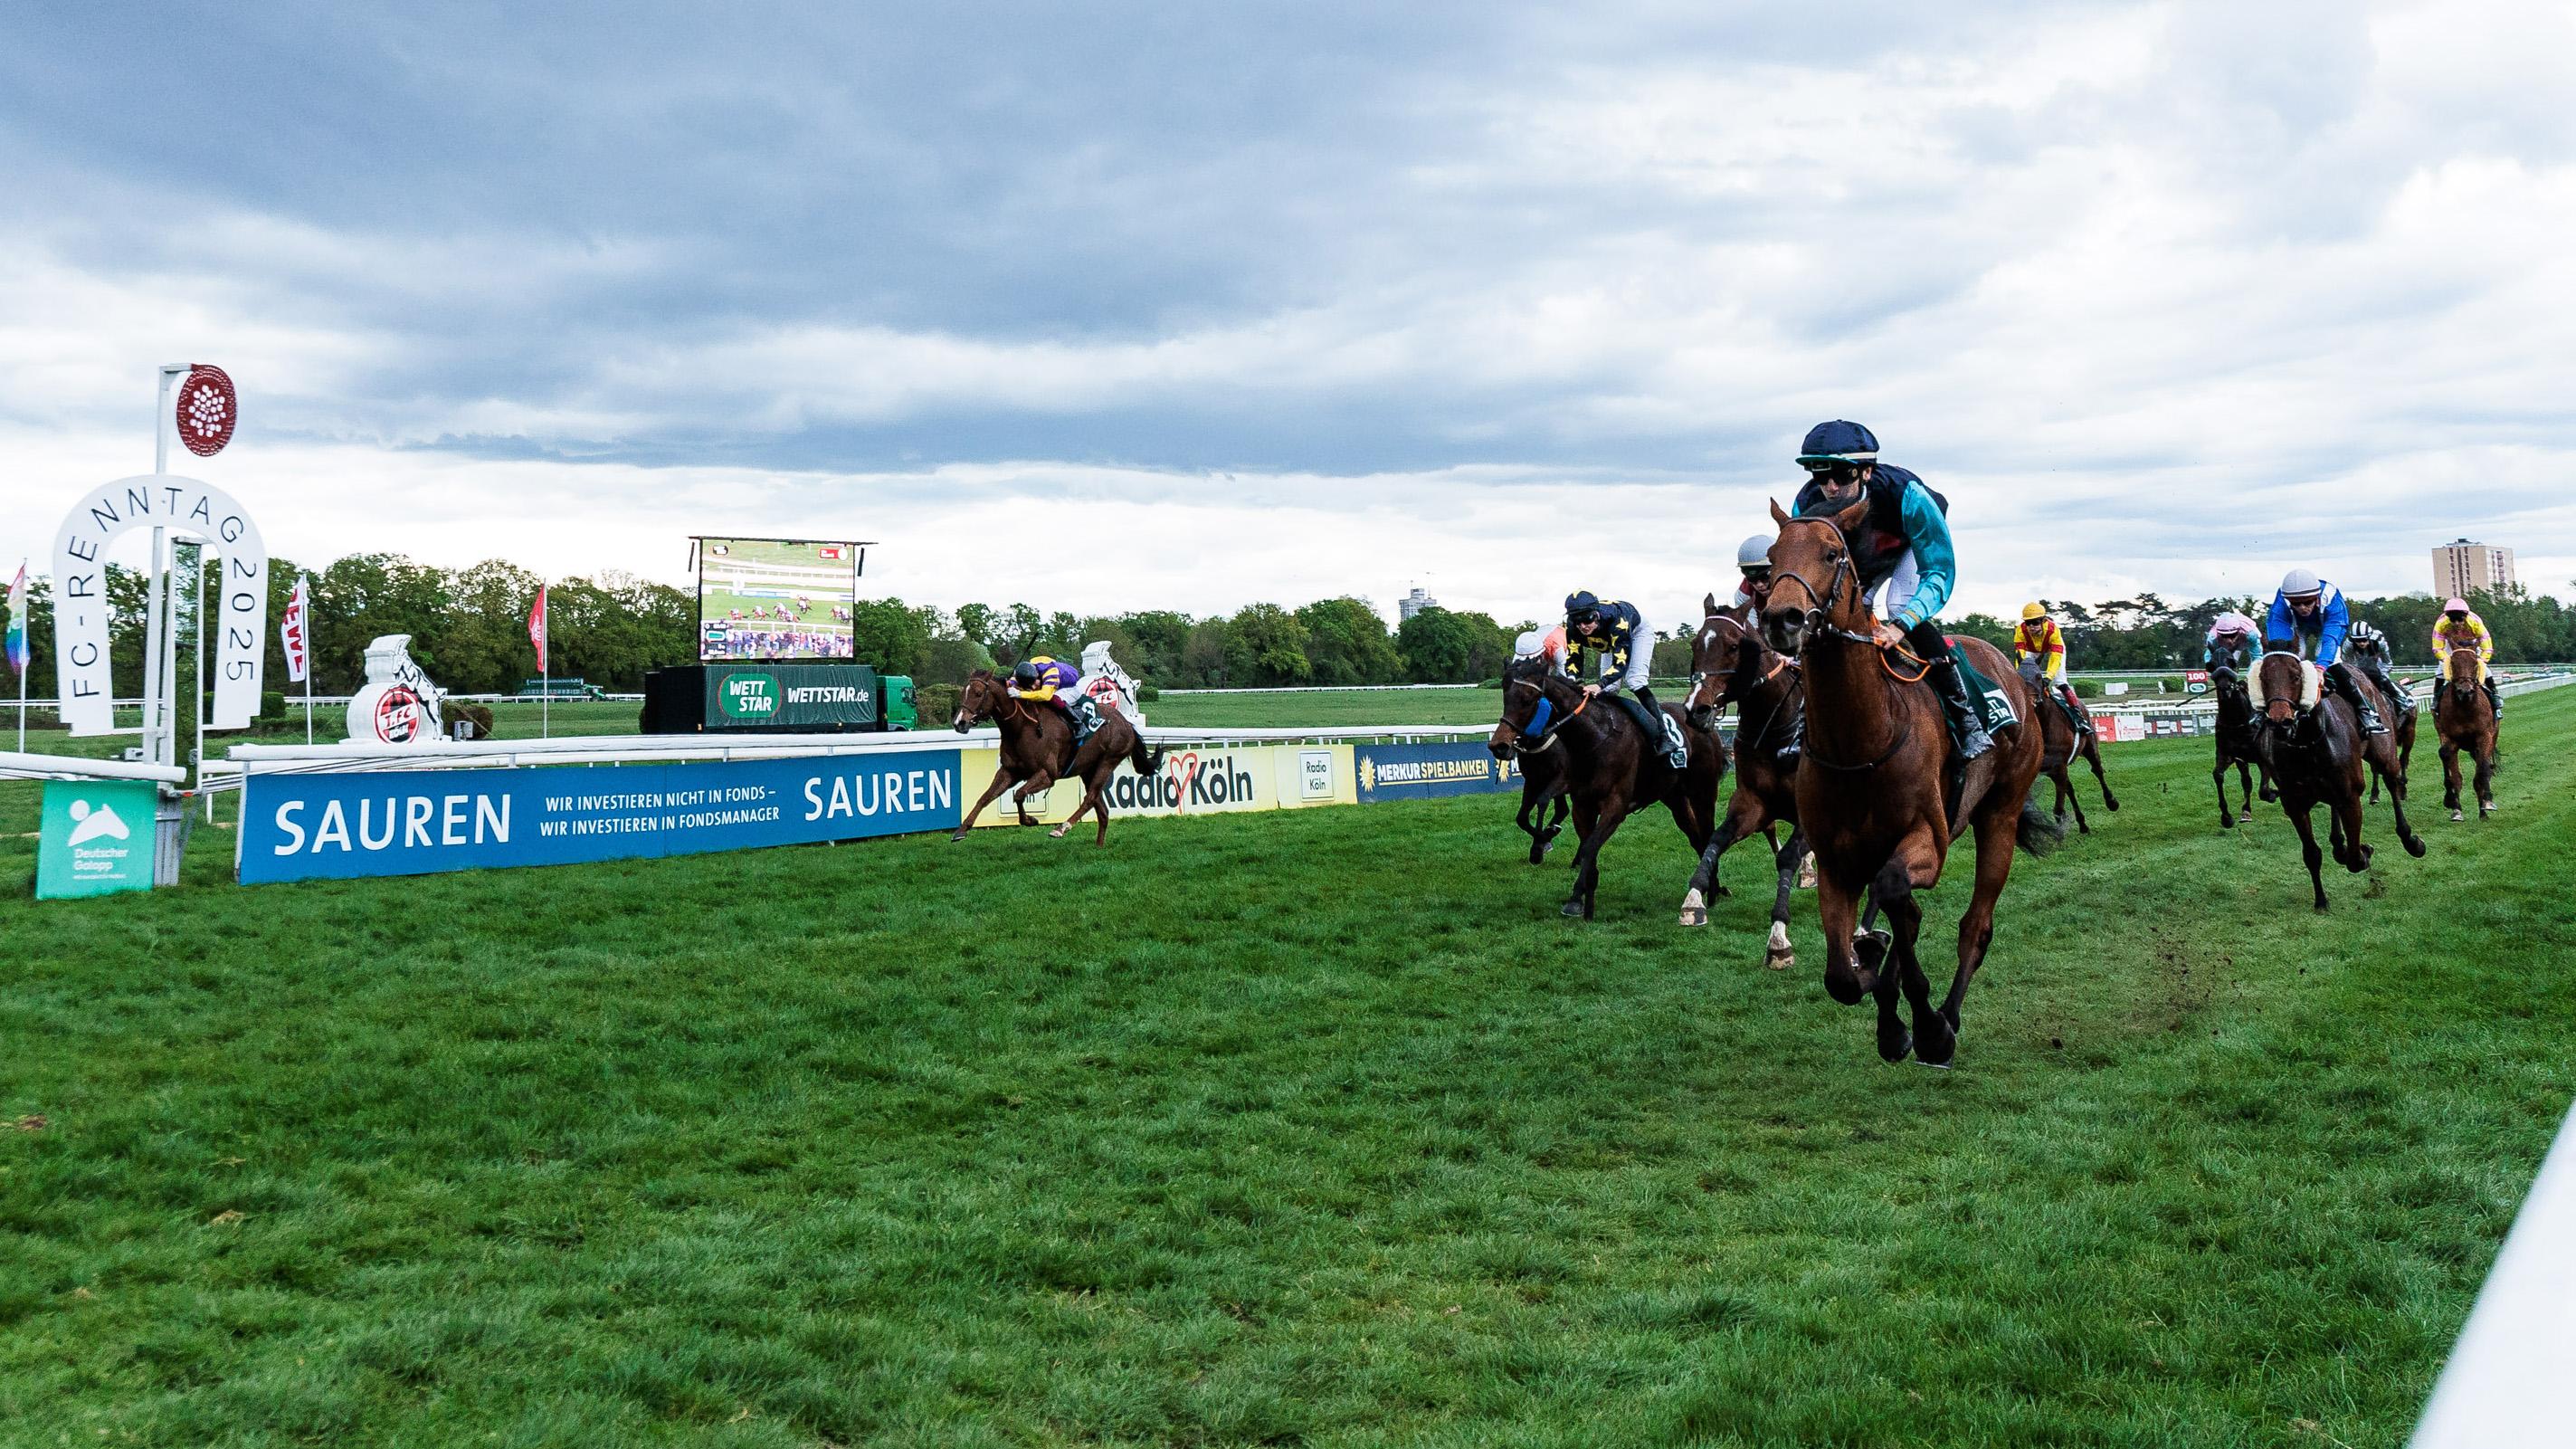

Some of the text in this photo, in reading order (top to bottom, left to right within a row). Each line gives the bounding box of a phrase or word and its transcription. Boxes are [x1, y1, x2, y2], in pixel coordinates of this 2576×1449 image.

[68, 486, 257, 698] FC-RENNTAG 2025
[729, 681, 765, 696] WETT
[2187, 672, 2206, 681] 100
[738, 696, 773, 712] STAR
[787, 686, 870, 703] WETTSTAR.de
[1306, 760, 1327, 774] Radio
[1377, 761, 1421, 782] MERKUR
[1421, 758, 1489, 779] SPIELBANKEN
[1188, 755, 1254, 806] Köln
[1309, 777, 1326, 791] Köln
[546, 796, 573, 812] WIR
[577, 794, 662, 812] INVESTIEREN
[666, 790, 705, 807] NICHT
[708, 789, 722, 804] IN
[726, 786, 765, 803] FONDS
[804, 768, 951, 822] SAUREN
[274, 794, 511, 856] SAUREN
[540, 806, 780, 836] WIR INVESTIEREN IN FONDSMANAGER
